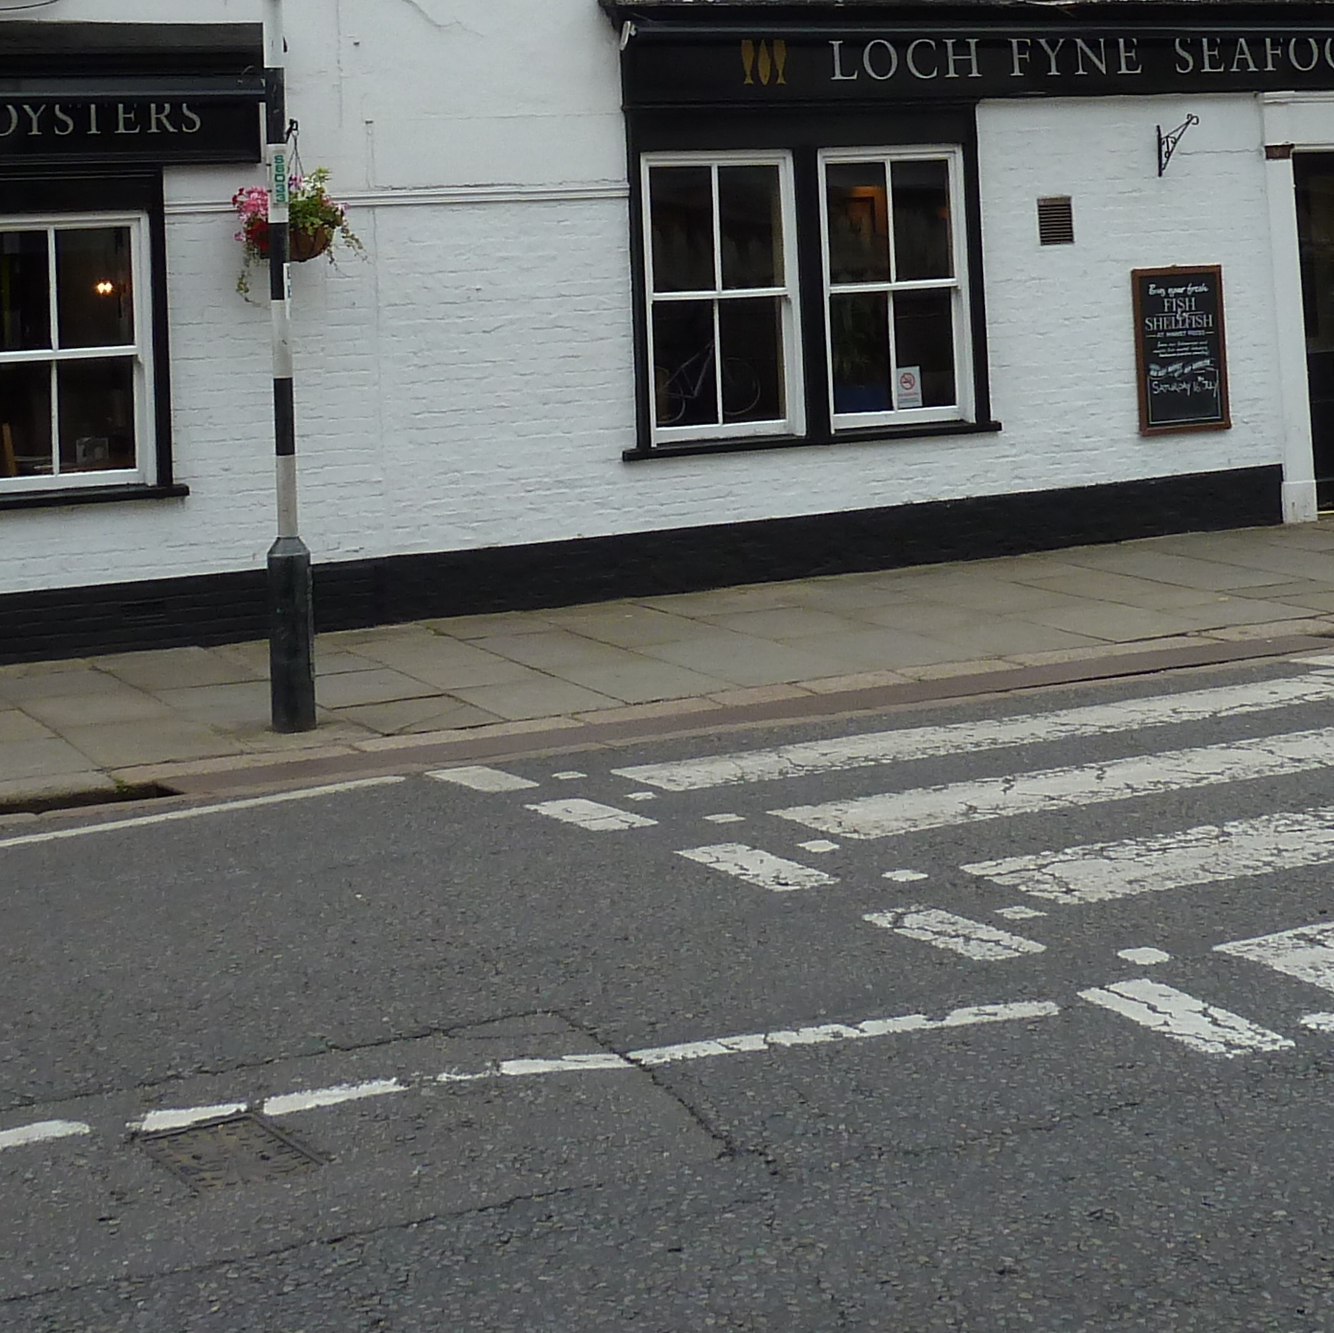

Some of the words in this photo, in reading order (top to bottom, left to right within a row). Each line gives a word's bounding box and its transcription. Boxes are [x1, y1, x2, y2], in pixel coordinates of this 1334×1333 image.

[828, 37, 983, 81] LOCH
[1008, 37, 1143, 77] FYNE
[1163, 297, 1196, 313] FISH
[1145, 314, 1214, 332] SHELLFISH
